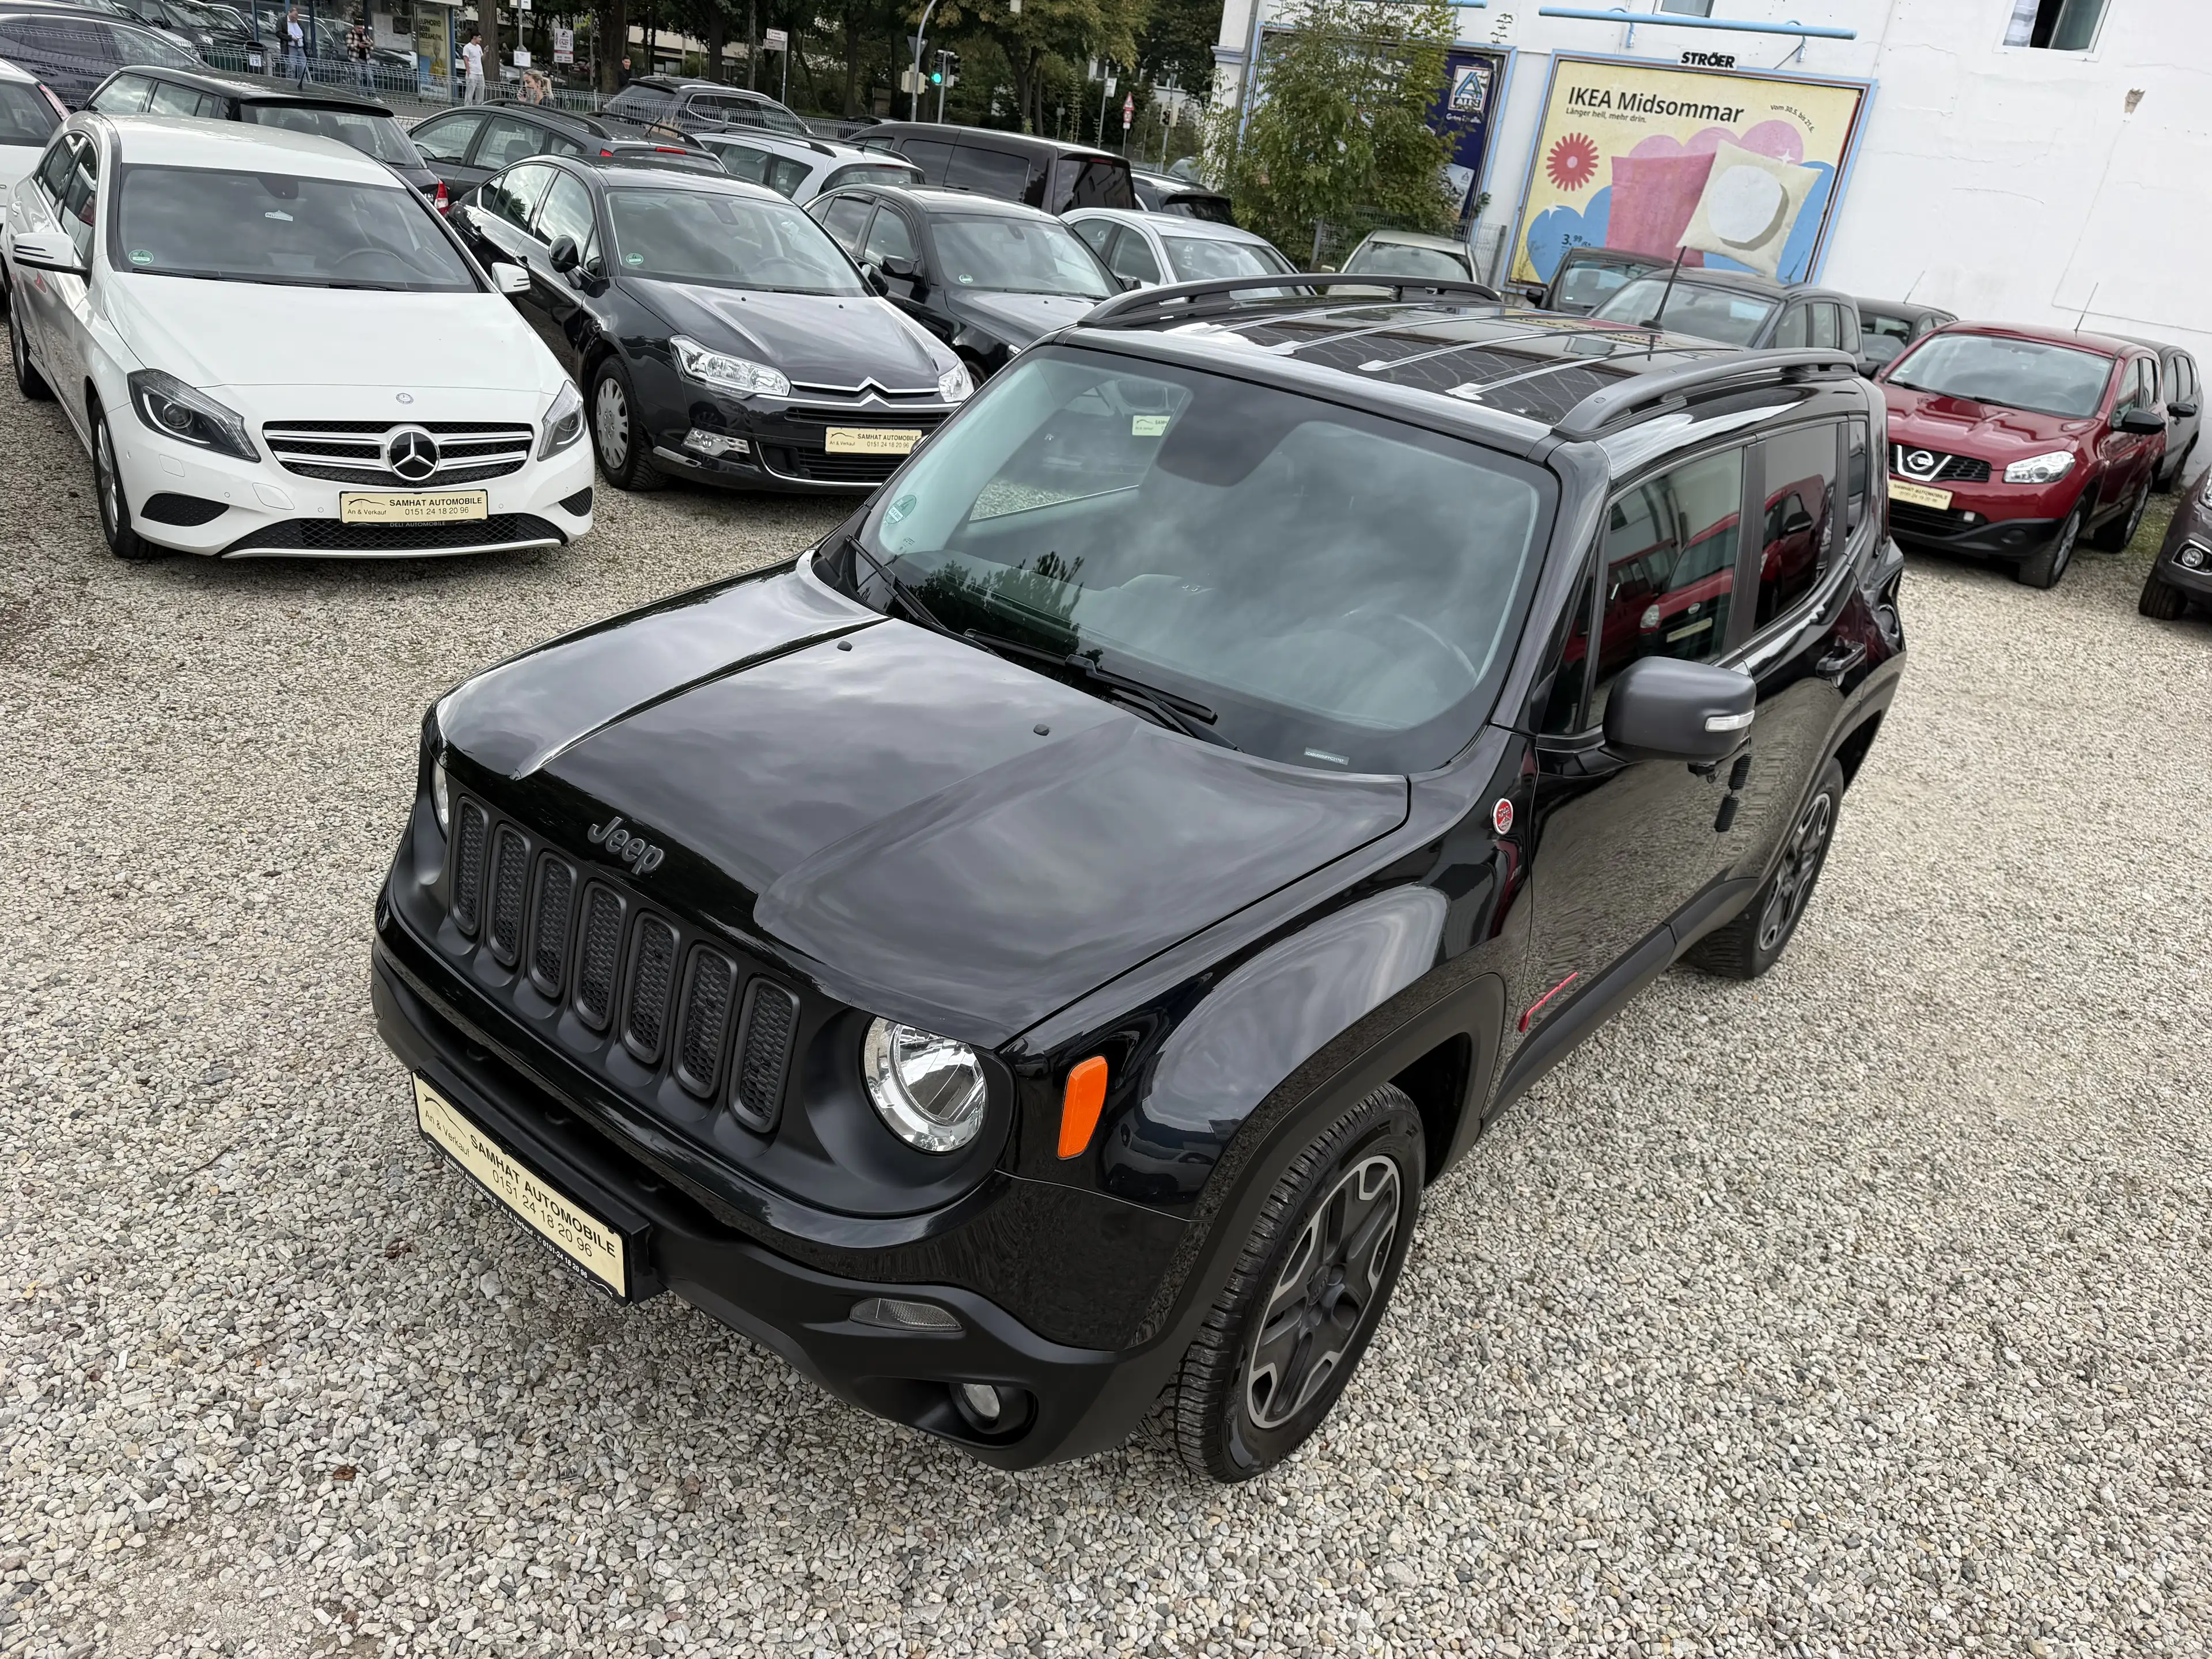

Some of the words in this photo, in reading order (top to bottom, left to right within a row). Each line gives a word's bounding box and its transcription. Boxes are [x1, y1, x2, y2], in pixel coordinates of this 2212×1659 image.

[1681, 51, 1736, 69] STRÖER
[1566, 107, 1590, 118] Länger
[1592, 110, 1607, 119] hell,
[1608, 113, 1628, 122] mehr
[1630, 115, 1647, 123] drin.
[1568, 86, 1611, 108] IKEA
[1618, 92, 1744, 123] Midsommar
[1798, 112, 1806, 121] bis
[429, 497, 482, 506] AUTOMOBILE
[587, 816, 665, 875] Jeep
[425, 1110, 434, 1124] An
[437, 1120, 441, 1131] &
[443, 1125, 469, 1157] Verkauf
[445, 1155, 465, 1176] SAMHAT
[465, 1173, 497, 1206] AUTOMOBILE
[501, 1205, 507, 1215] An
[509, 1212, 513, 1220] &
[513, 1216, 533, 1236] Verkauf
[543, 1240, 563, 1260] 0151-24
[565, 1257, 571, 1267] 18
[573, 1261, 579, 1272] 20
[580, 1269, 588, 1278] 96
[470, 1134, 520, 1184] SAMHAT
[525, 1181, 616, 1258] AUTOMOBILE
[493, 1169, 517, 1199] 0151
[522, 1195, 536, 1214] 24
[541, 1210, 554, 1229] 18
[558, 1223, 573, 1243] 20
[577, 1237, 592, 1257] 96
